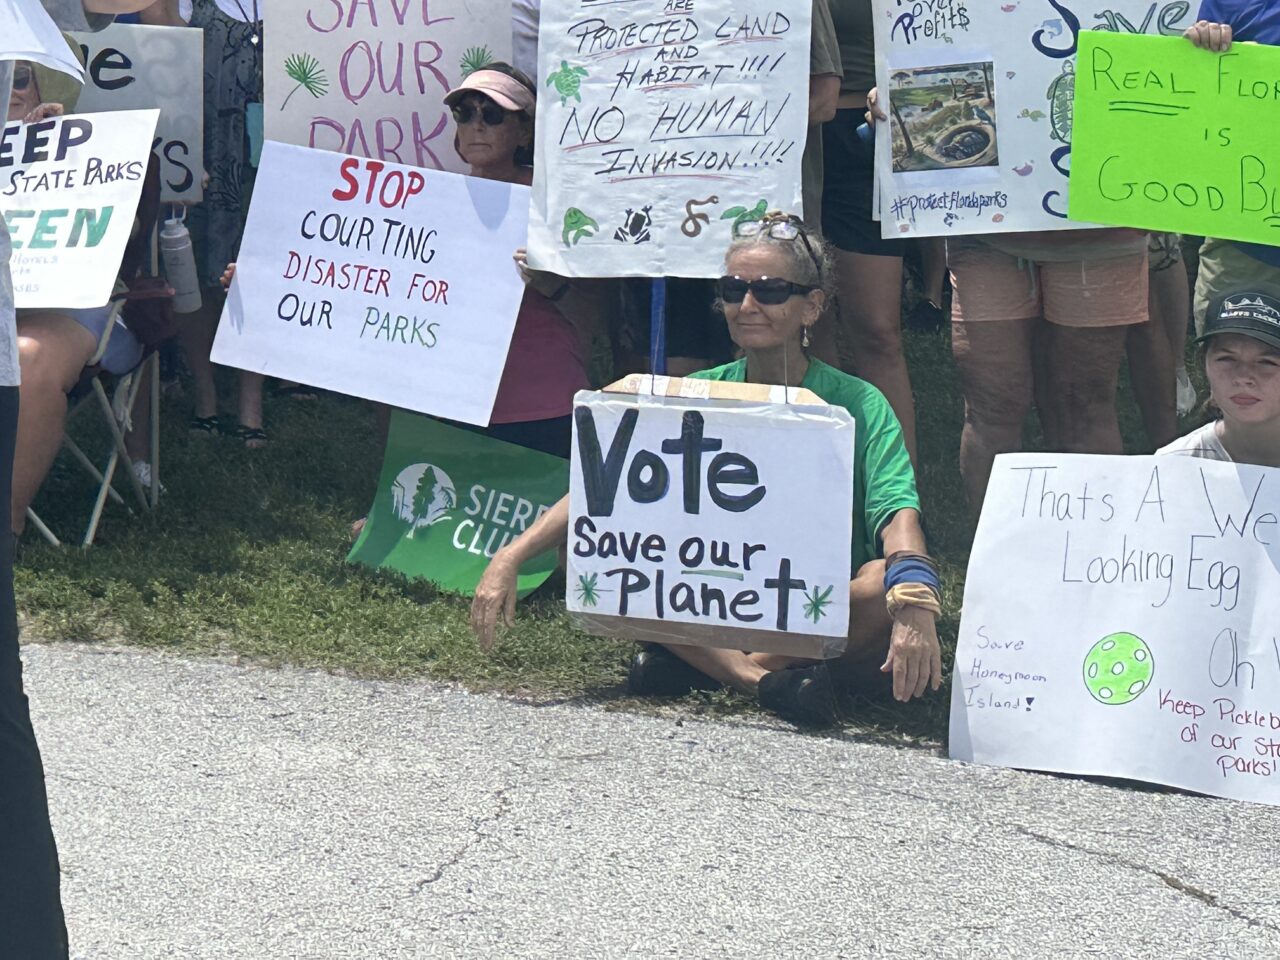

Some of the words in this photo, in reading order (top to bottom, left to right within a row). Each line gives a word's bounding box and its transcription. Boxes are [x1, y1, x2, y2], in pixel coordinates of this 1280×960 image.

[568, 17, 699, 54] PROTECTED
[715, 11, 790, 38] LAND
[654, 45, 699, 62] AND
[339, 40, 451, 105] OUR
[1092, 46, 1196, 94] REAL
[560, 106, 625, 145] NO
[650, 92, 791, 141] HUMAN
[1205, 127, 1231, 147] IS
[3, 170, 76, 196] STATE
[83, 157, 143, 186] PARKS
[332, 158, 425, 210] STOP
[1098, 155, 1224, 212] GOOD
[301, 211, 437, 264] COURTING
[283, 251, 391, 298] DISASTER
[407, 273, 449, 305] FOR
[277, 293, 332, 330] OUR
[360, 306, 440, 349] PARKS
[575, 405, 766, 517] Vote
[1010, 466, 1115, 522] Thats
[1135, 465, 1164, 523] A
[452, 519, 518, 558] CLU
[573, 516, 666, 563] Save
[679, 537, 766, 571] our
[603, 558, 806, 631] Planet
[1062, 530, 1173, 608] Looking
[1187, 535, 1241, 611] Egg
[976, 624, 1025, 651] Save
[1209, 628, 1255, 690] Oh
[970, 658, 1047, 683] Honeymoon
[1159, 688, 1206, 719] Keep
[1181, 723, 1199, 742] of
[1211, 734, 1242, 750] our
